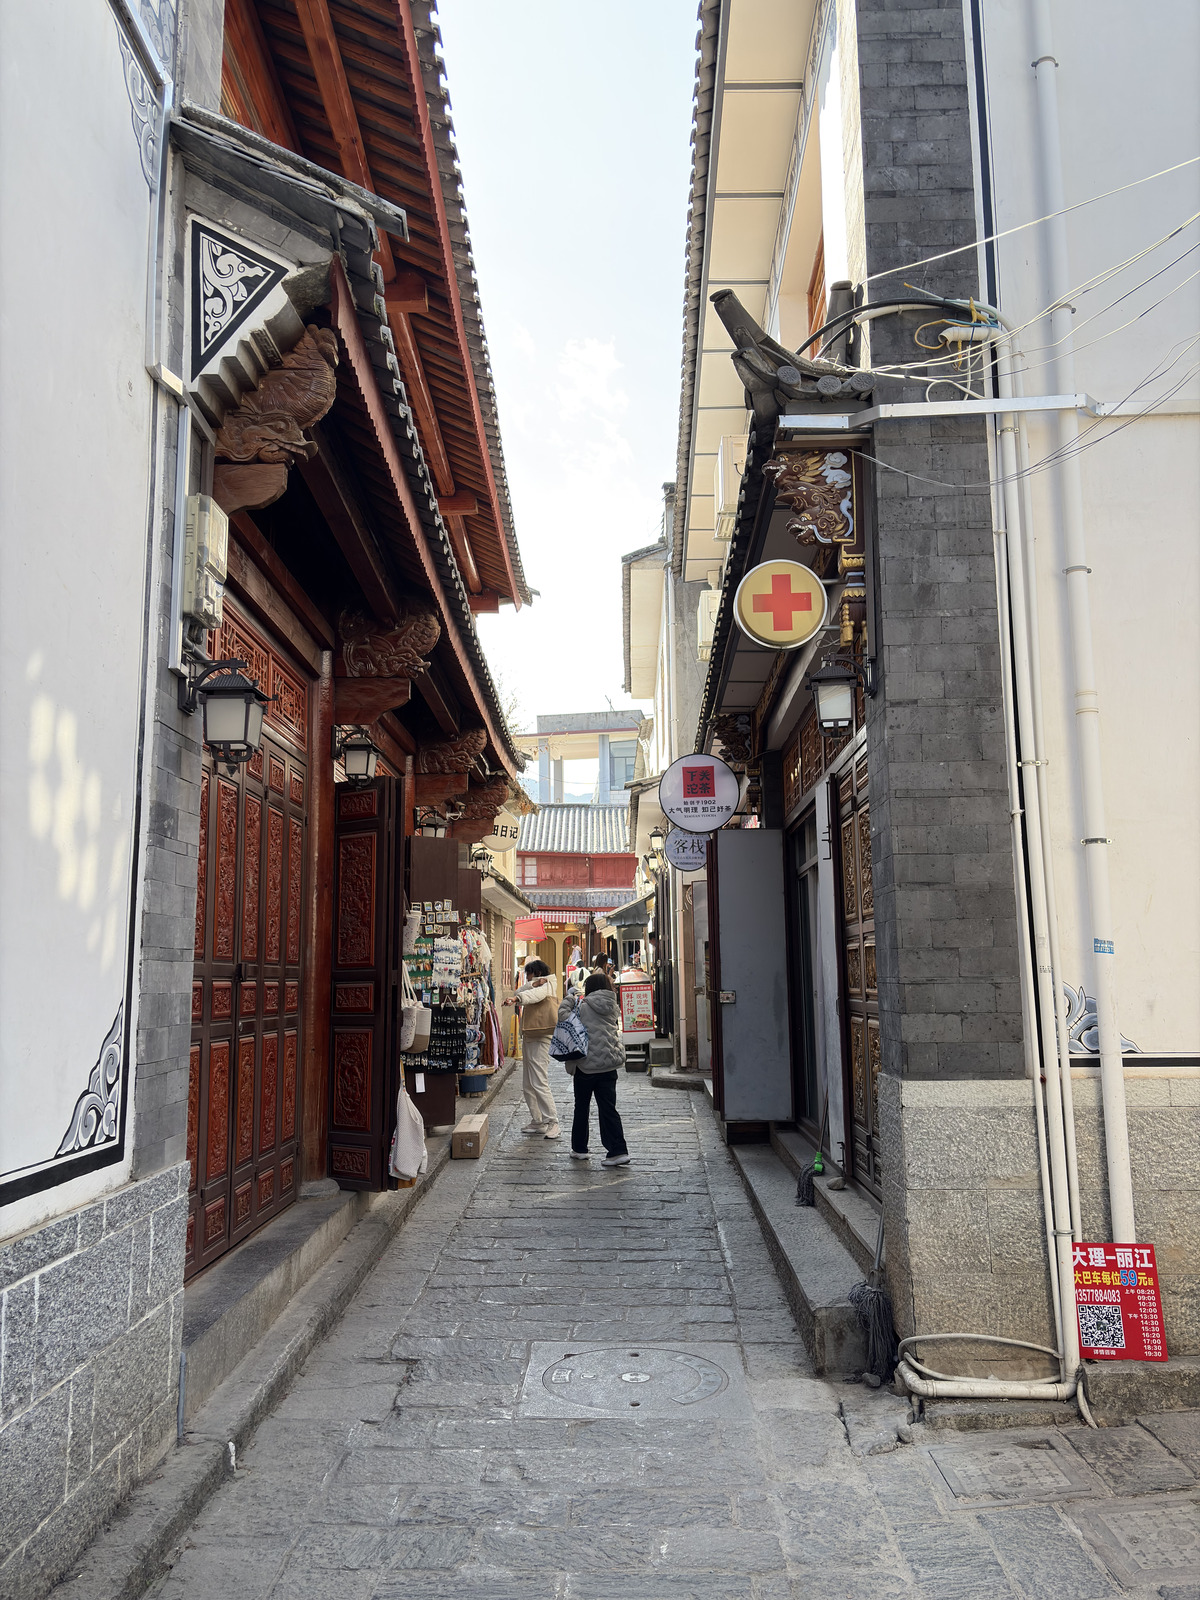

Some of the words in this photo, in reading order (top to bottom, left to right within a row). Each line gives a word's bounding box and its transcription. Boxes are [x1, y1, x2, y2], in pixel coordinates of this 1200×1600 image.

[687, 770, 711, 782] 下关
[687, 783, 711, 795] 沱茶
[668, 806, 699, 814] 大气明理
[701, 805, 732, 813] 知己好茶
[673, 839, 705, 855] 客栈
[626, 992, 635, 1015] 鲜花饼
